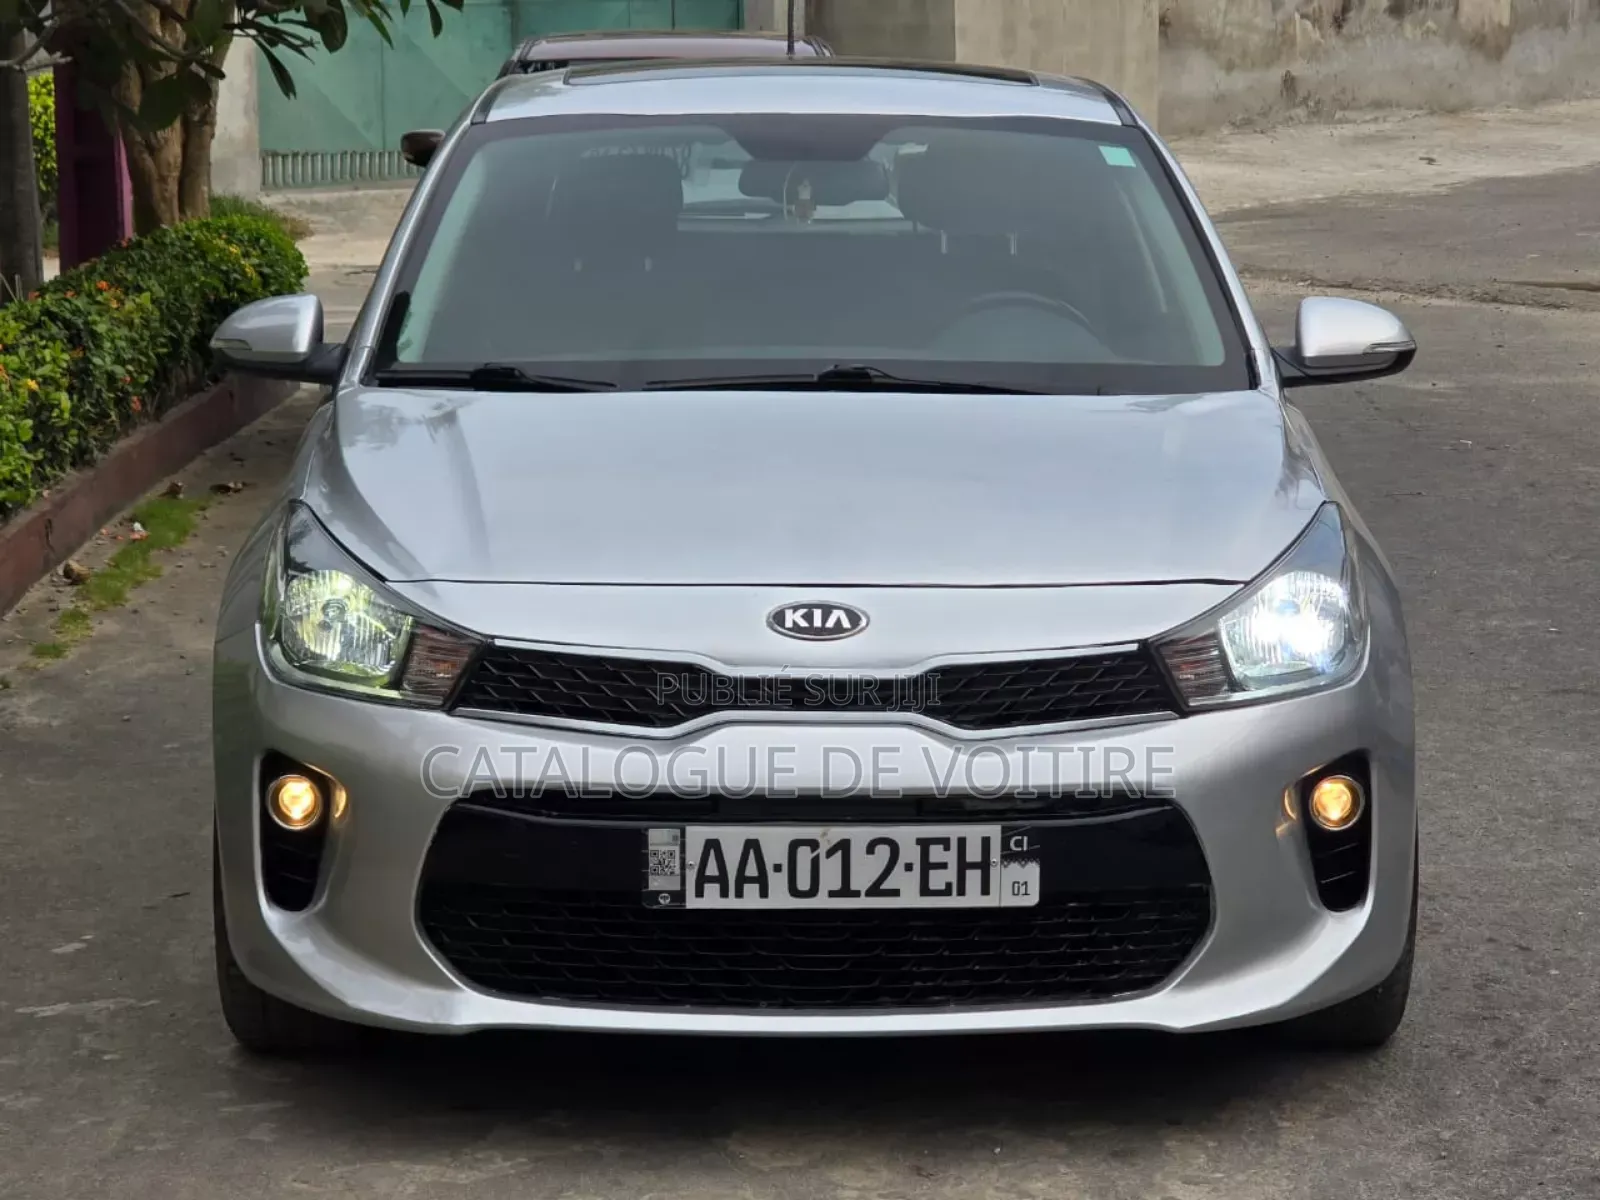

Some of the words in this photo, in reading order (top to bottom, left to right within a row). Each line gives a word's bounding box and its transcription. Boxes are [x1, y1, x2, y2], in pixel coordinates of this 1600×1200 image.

[785, 608, 851, 629] KIA
[1010, 836, 1028, 851] CI
[1012, 881, 1031, 896] 01
